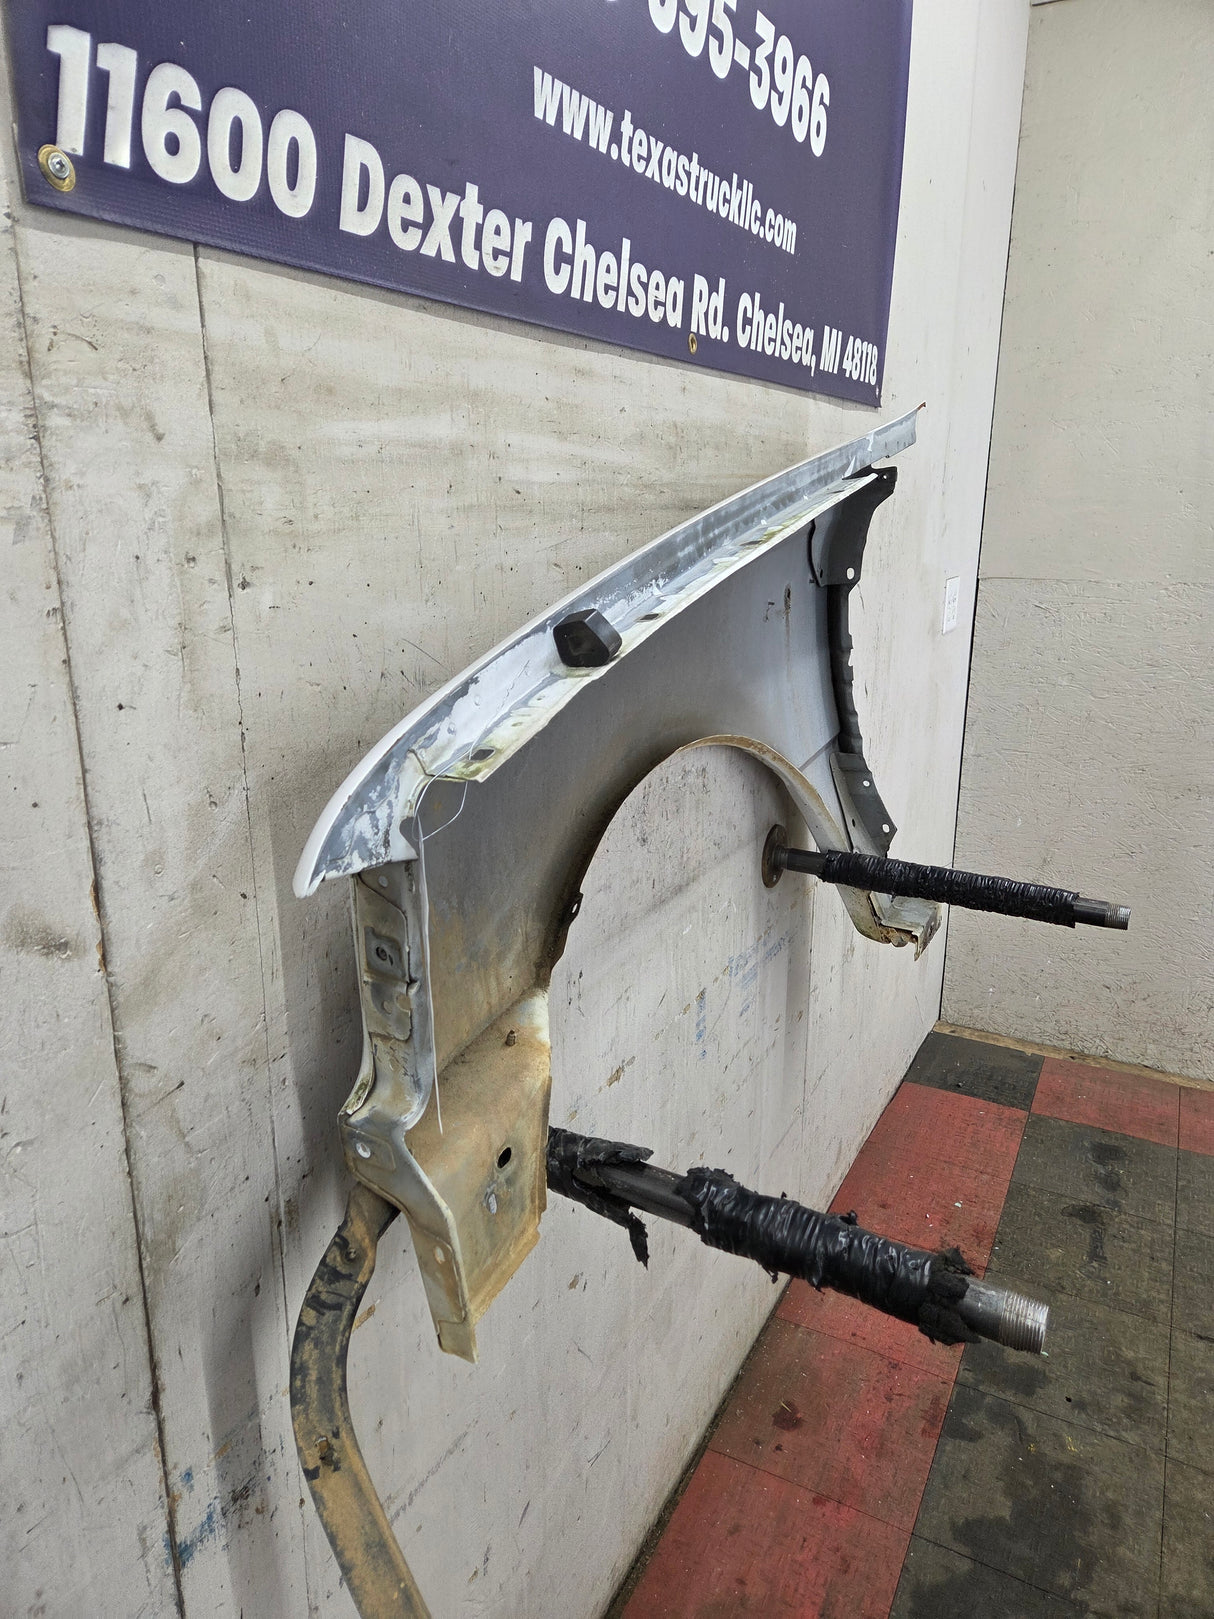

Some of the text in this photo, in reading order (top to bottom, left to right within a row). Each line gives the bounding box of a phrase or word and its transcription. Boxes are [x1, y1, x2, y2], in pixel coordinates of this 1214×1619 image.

[45, 24, 879, 386] 11600 Dexter Chelsea Rd. Chelsea, MI 48118
[533, 65, 797, 255] www.texastruckllc.com
